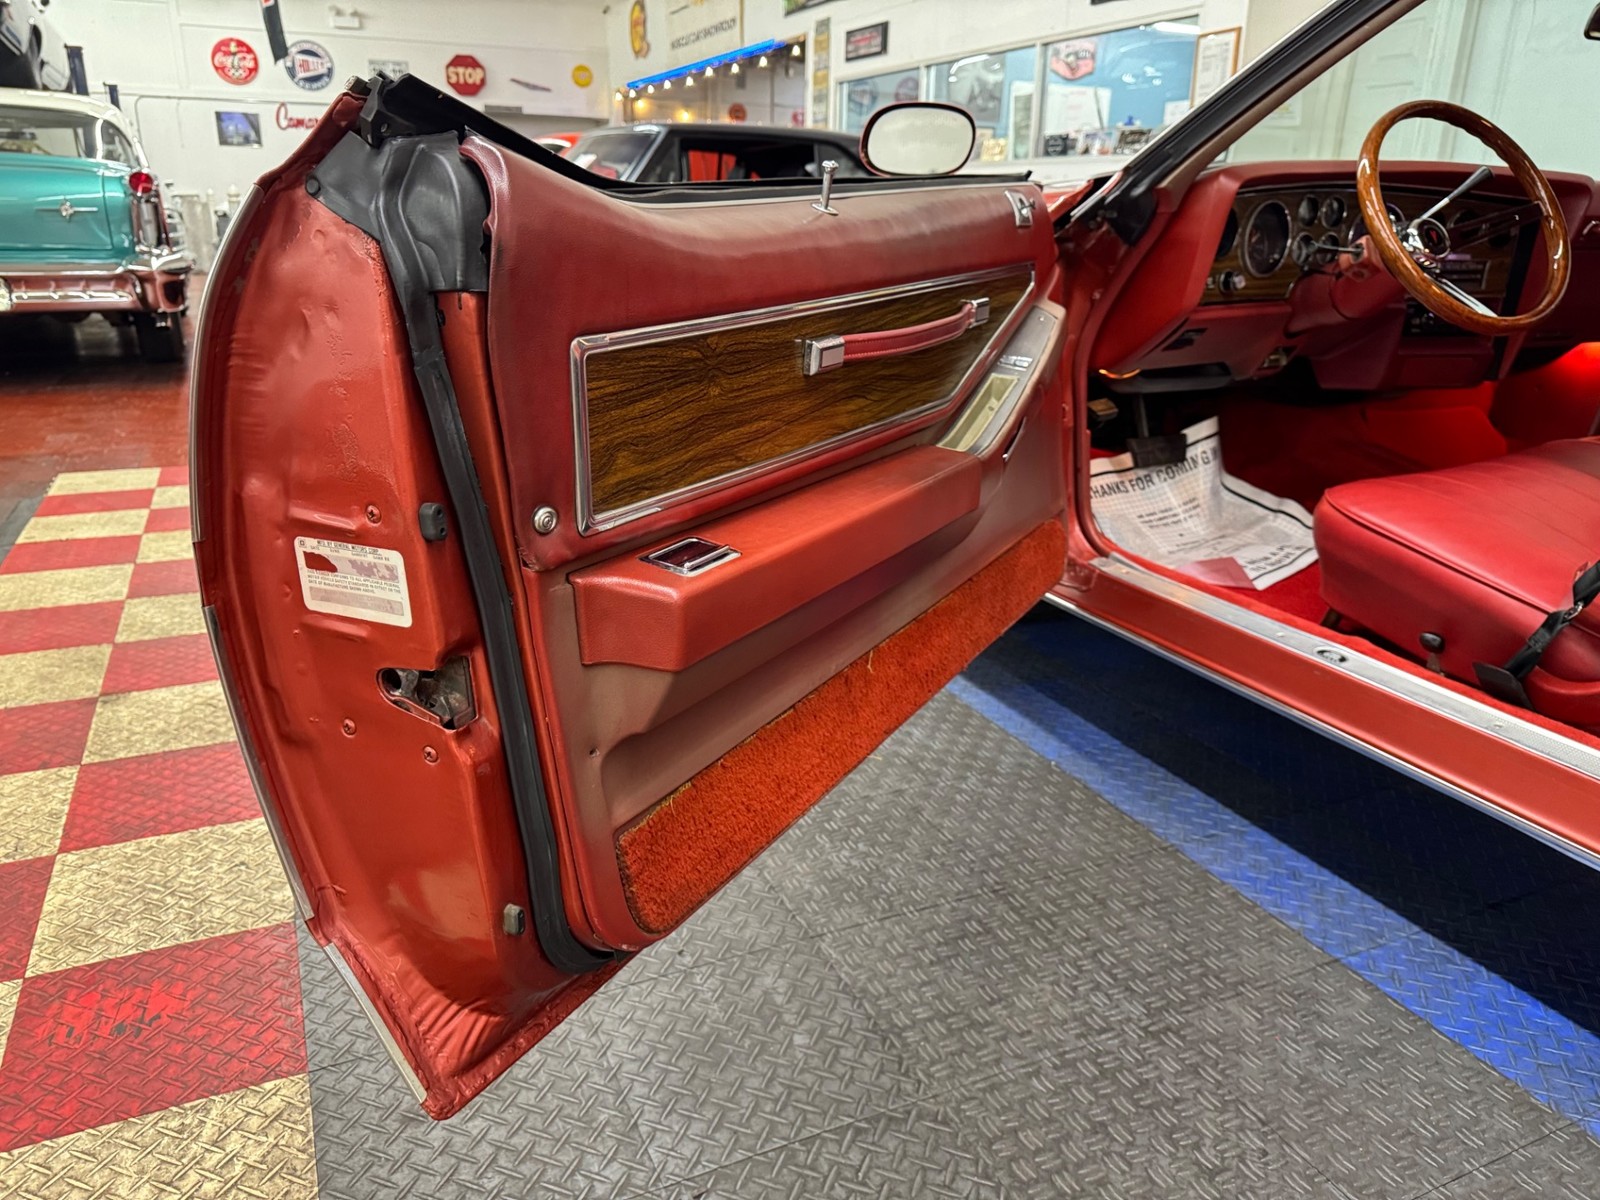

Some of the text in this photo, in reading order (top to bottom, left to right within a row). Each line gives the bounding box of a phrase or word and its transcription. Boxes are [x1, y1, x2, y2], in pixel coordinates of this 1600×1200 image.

[448, 66, 484, 85] STOP
[1130, 475, 1155, 491] FOR
[1158, 450, 1211, 481] COMING
